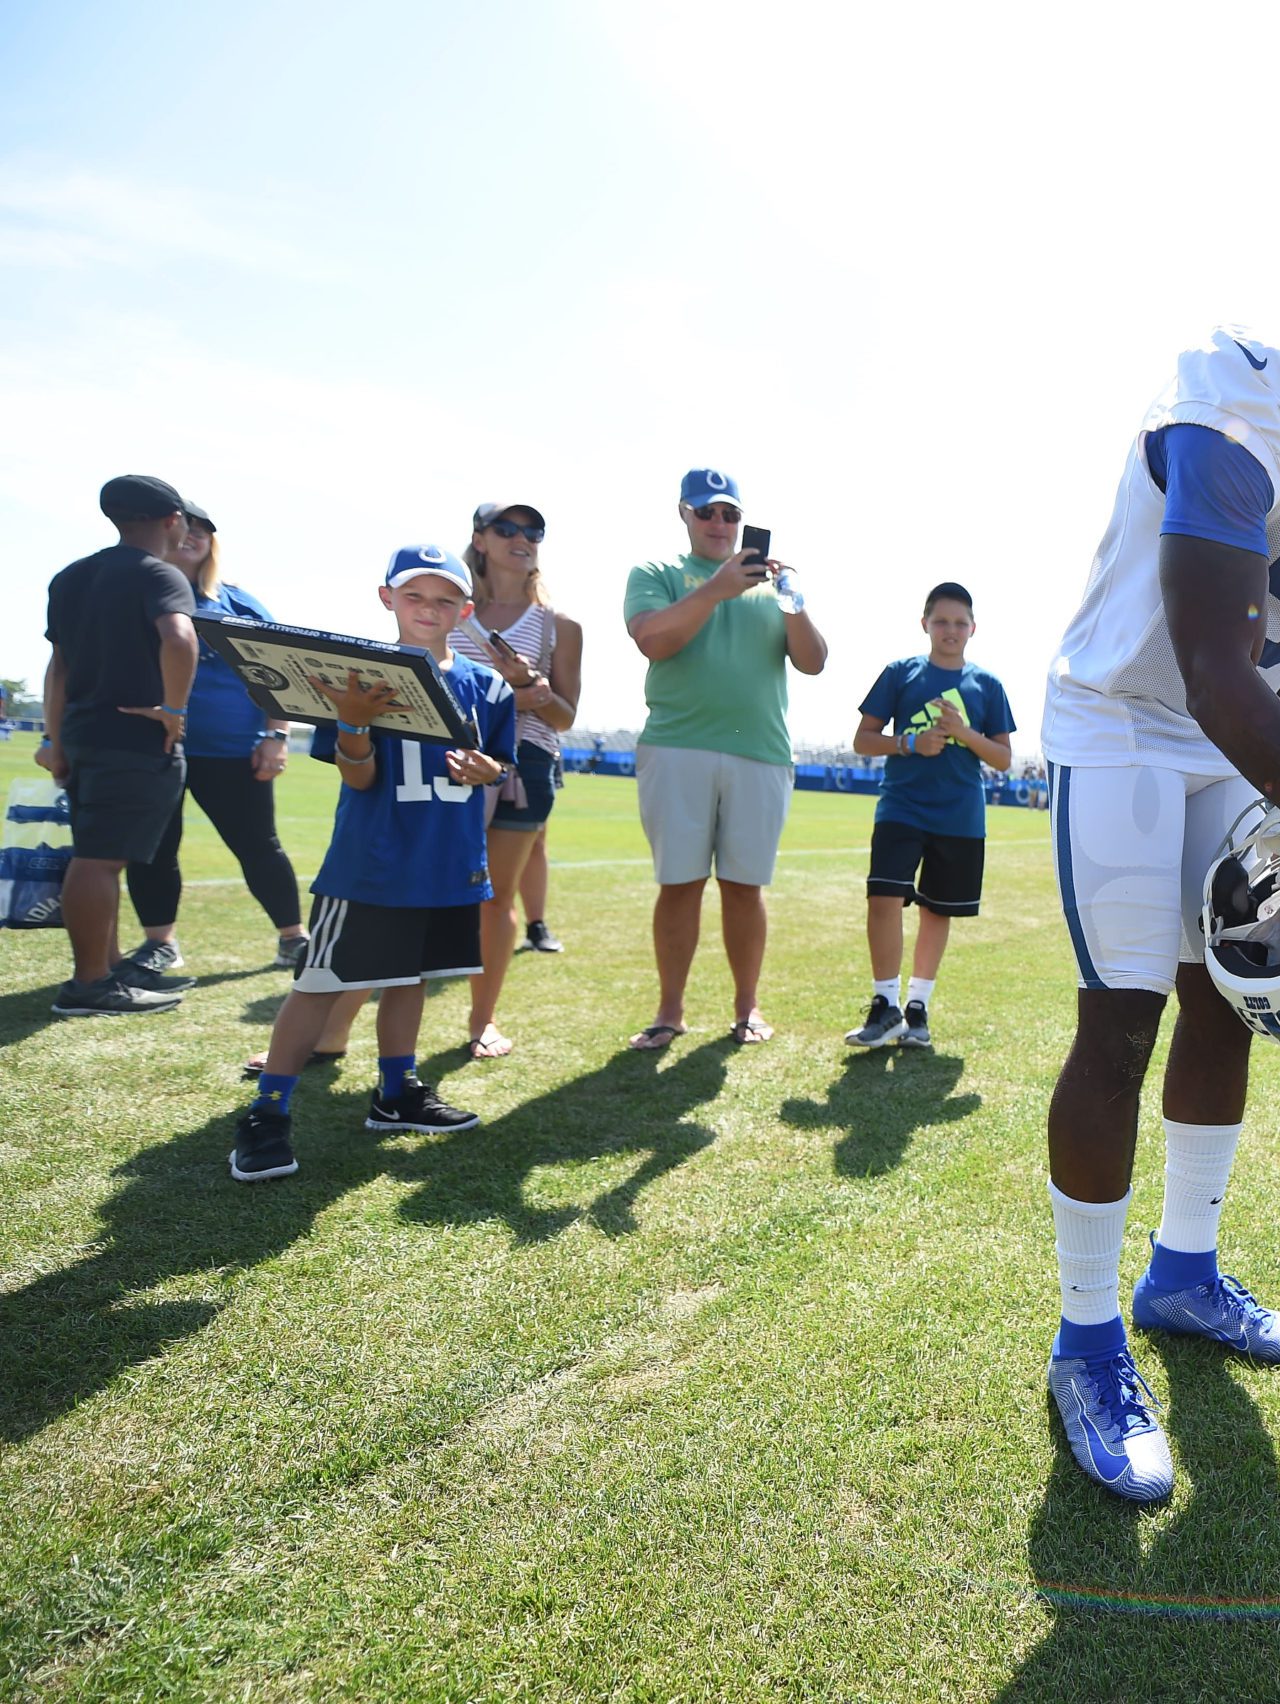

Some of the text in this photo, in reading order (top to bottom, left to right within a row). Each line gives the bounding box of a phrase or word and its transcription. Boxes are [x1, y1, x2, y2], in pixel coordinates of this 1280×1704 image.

[222, 616, 401, 652] READY TO HANG OFFICIALLY LICENSED
